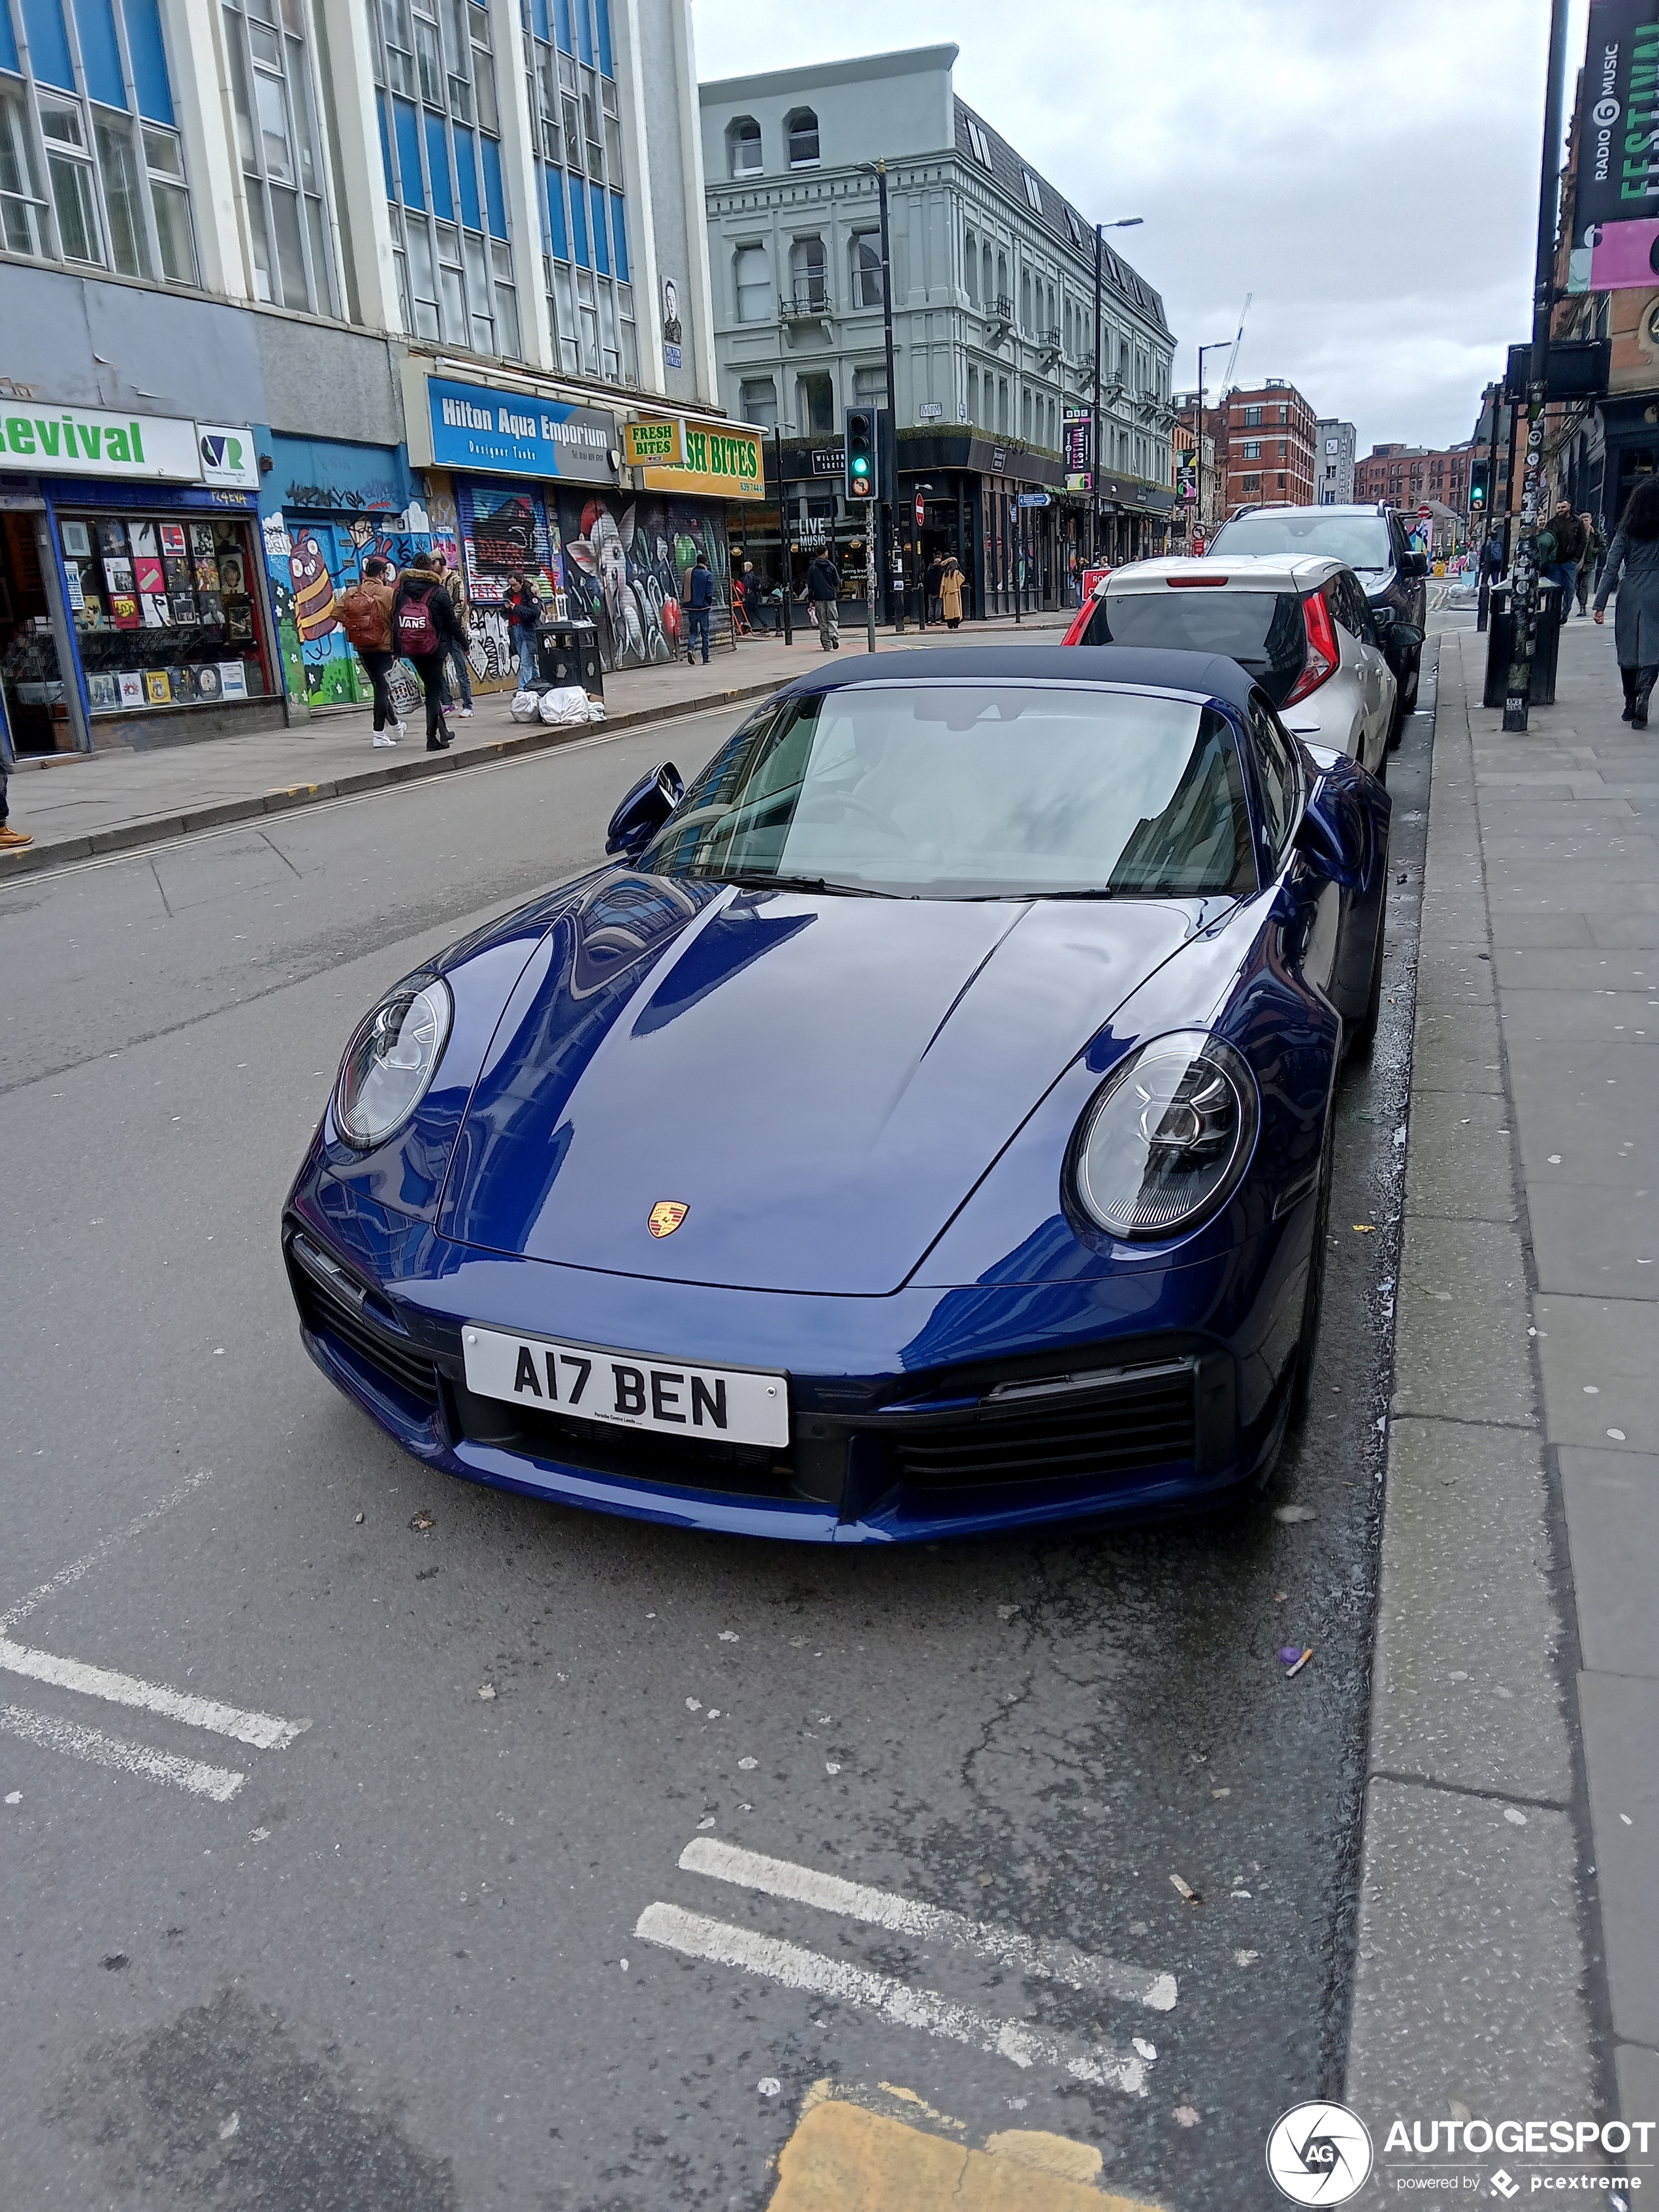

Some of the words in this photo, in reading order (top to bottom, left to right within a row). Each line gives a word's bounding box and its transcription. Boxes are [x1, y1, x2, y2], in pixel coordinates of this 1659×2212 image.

[1602, 41, 1619, 96] MUSIC
[1595, 128, 1611, 181] RADIO
[666, 347, 681, 357] HILTON
[666, 357, 681, 367] STREET
[442, 398, 492, 431] Hilton
[498, 408, 536, 440] Aqua
[540, 415, 608, 449] Emporium
[0, 414, 145, 462] evival
[632, 425, 673, 441] FRESH
[469, 440, 509, 459] Designer
[513, 445, 537, 461] Tanks
[636, 440, 671, 456] BITES
[1072, 426, 1084, 470] FESTIVAL
[710, 436, 758, 479] BITES
[740, 482, 749, 491] 839
[750, 483, 763, 493] 7444
[799, 518, 825, 534] LIVE
[799, 534, 826, 546] MUSIC
[398, 616, 427, 628] VANS
[513, 1345, 592, 1404] A17
[611, 1364, 728, 1430] BEN
